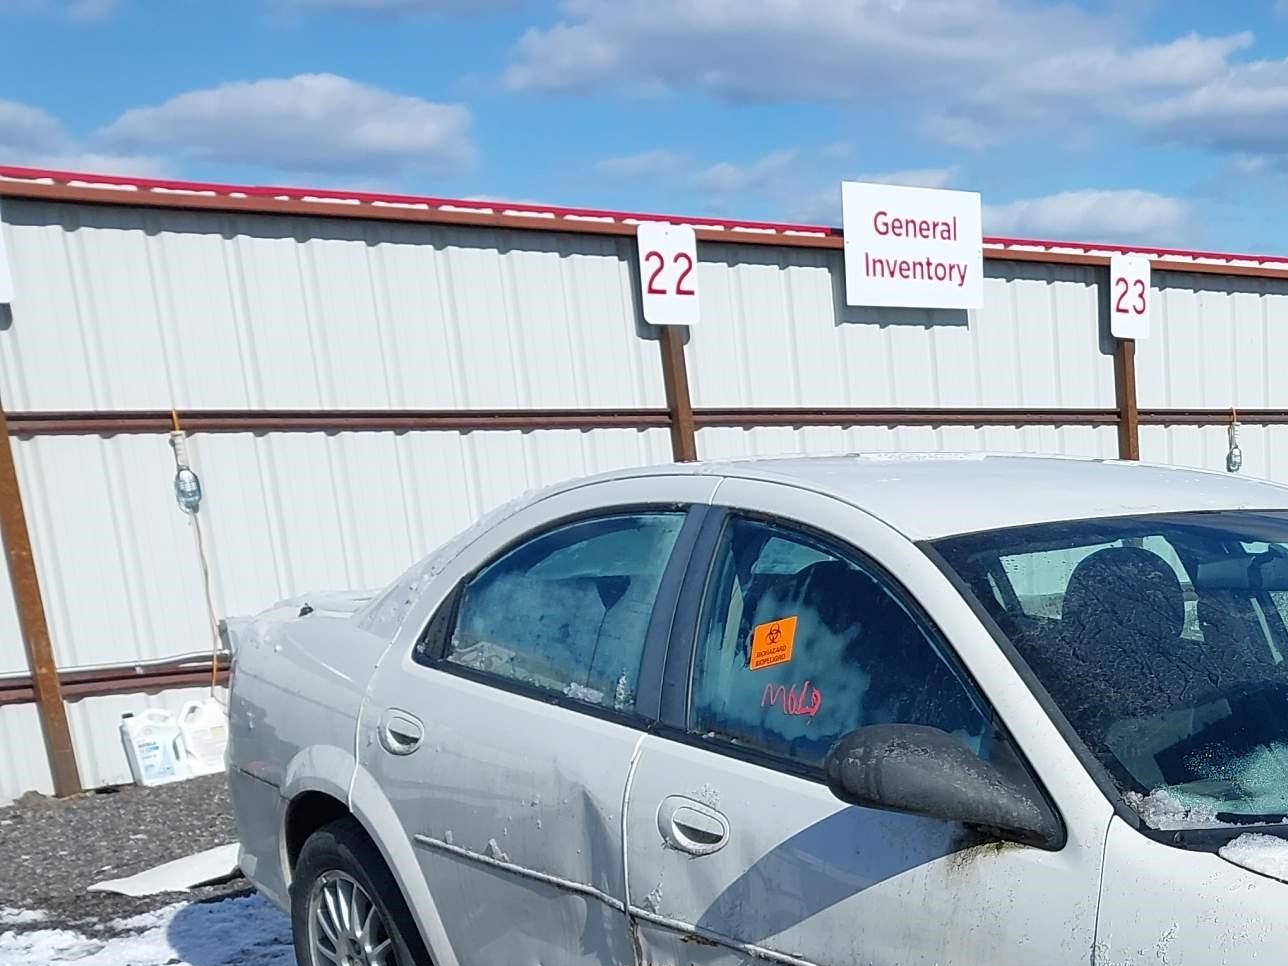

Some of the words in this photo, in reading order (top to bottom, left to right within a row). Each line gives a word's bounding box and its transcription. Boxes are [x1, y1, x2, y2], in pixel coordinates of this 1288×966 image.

[873, 210, 957, 241] General
[644, 250, 695, 296] 22
[864, 252, 967, 288] Inventory
[1115, 276, 1147, 315] 23
[756, 645, 787, 658] BIOHAZARD
